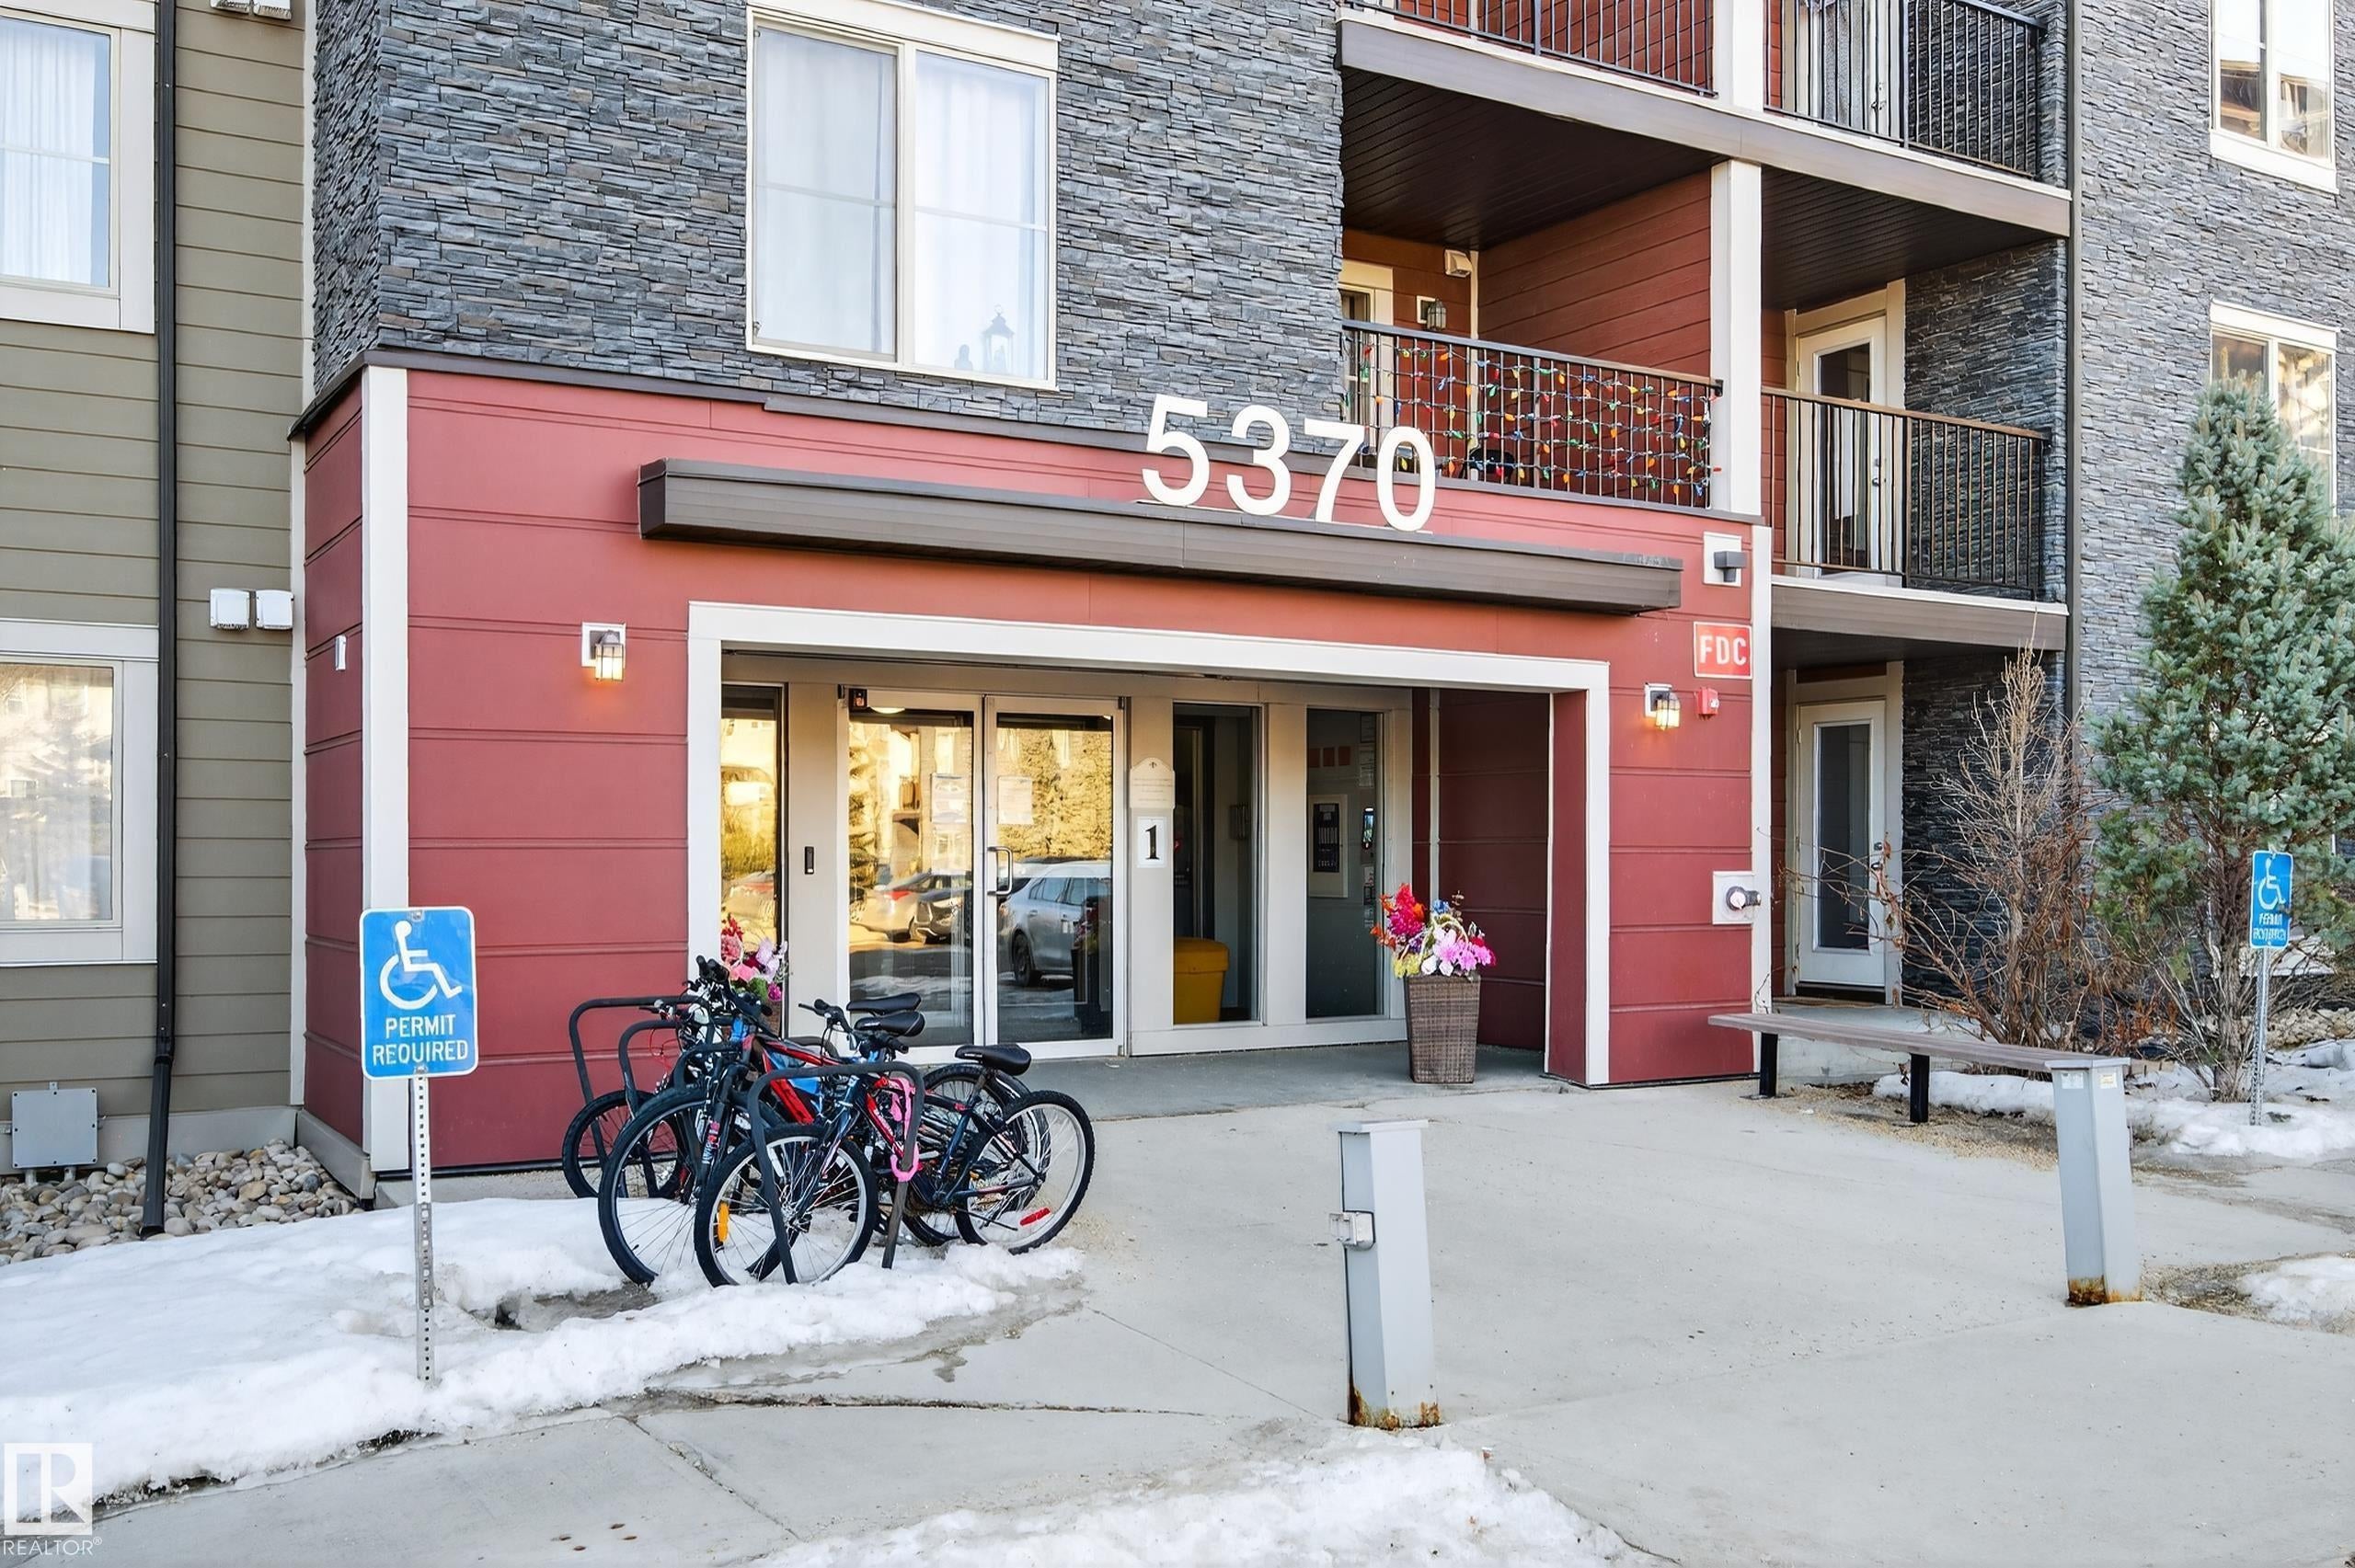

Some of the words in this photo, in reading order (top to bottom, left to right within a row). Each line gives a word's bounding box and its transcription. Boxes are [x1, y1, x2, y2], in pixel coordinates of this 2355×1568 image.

[1142, 394, 1435, 532] 5370
[1699, 635, 1747, 666] FDC
[1144, 824, 1160, 861] 1
[385, 1013, 456, 1039] PERMIT
[373, 1040, 468, 1066] REQUIRED
